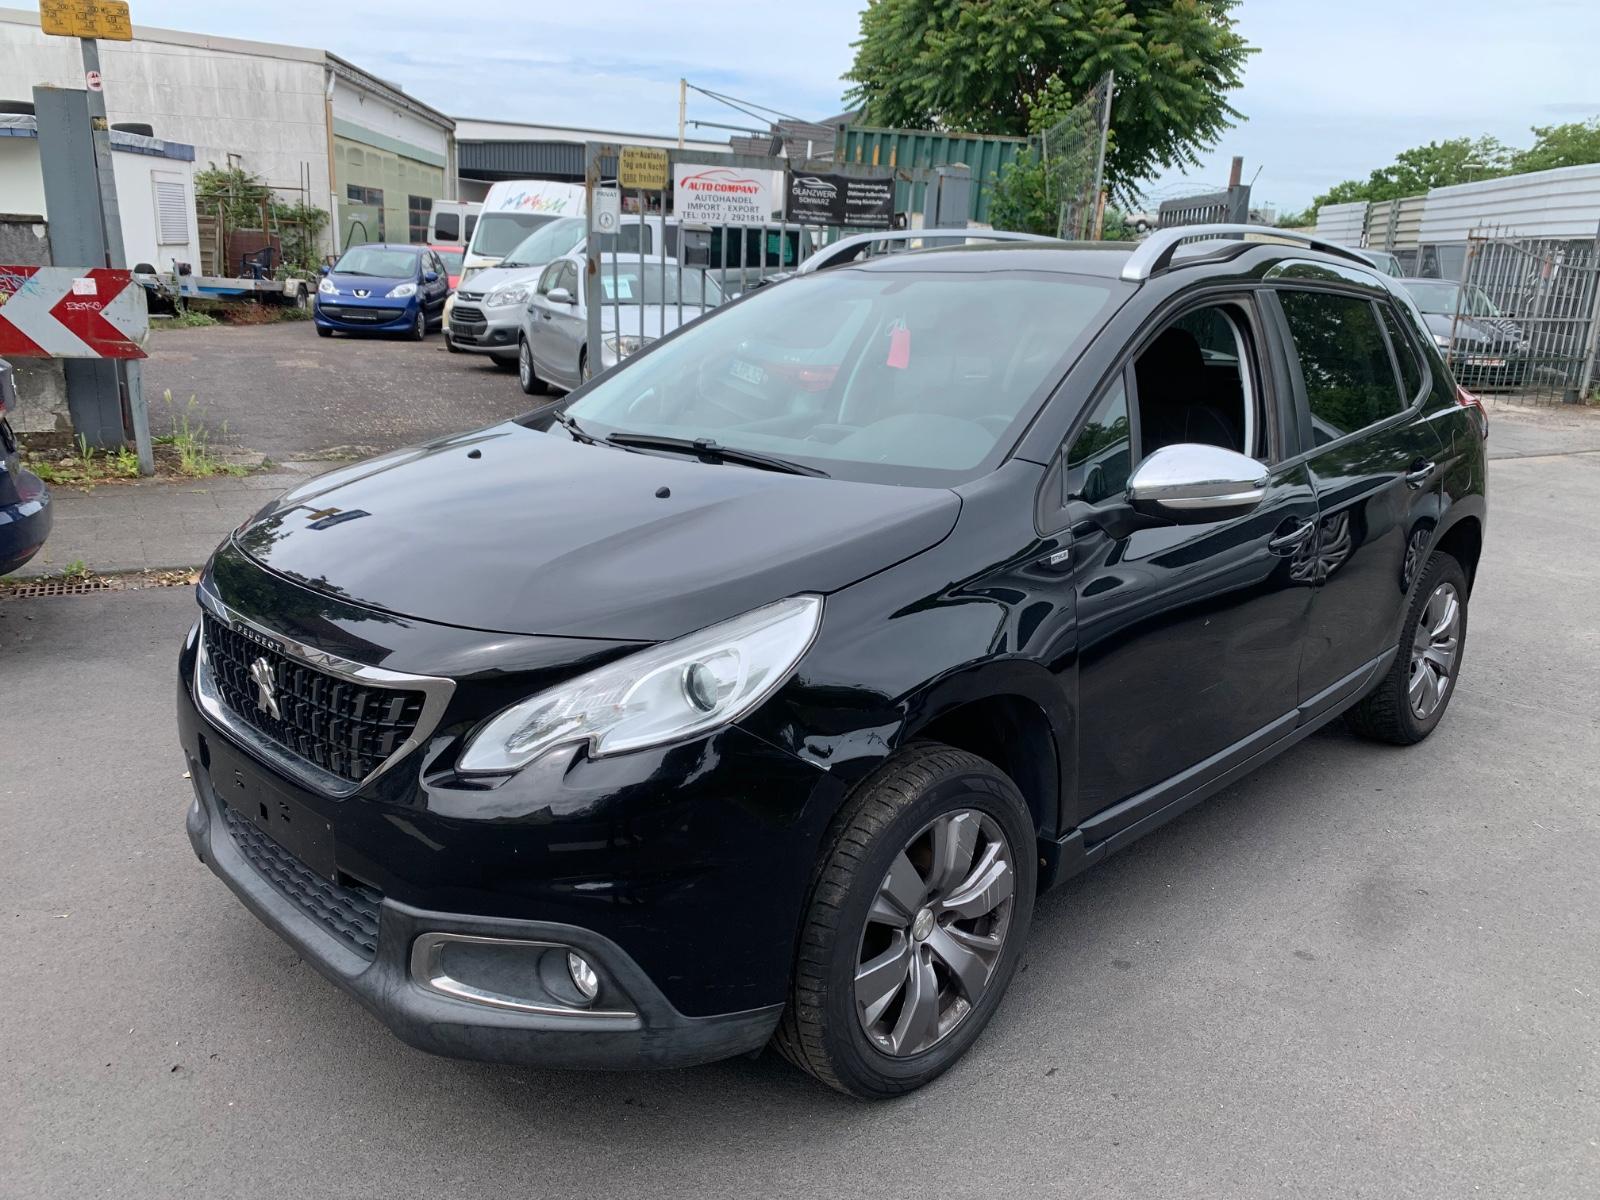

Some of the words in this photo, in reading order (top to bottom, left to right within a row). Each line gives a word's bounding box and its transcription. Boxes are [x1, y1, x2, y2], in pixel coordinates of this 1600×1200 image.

[623, 160, 634, 170] Tag
[648, 162, 667, 172] Nacht
[688, 181, 713, 191] AUTO
[714, 183, 759, 194] COMPANY
[792, 187, 837, 199] GLANZWERK
[694, 193, 753, 204] AUTOHANDEL
[798, 196, 830, 206] SCHWARZ
[687, 202, 720, 211] IMPORT
[727, 204, 760, 213] EXPORT
[682, 211, 699, 219] TEL:
[701, 212, 720, 220] 0172
[731, 213, 765, 222] 2921814
[237, 624, 281, 652] PEUGEOT
